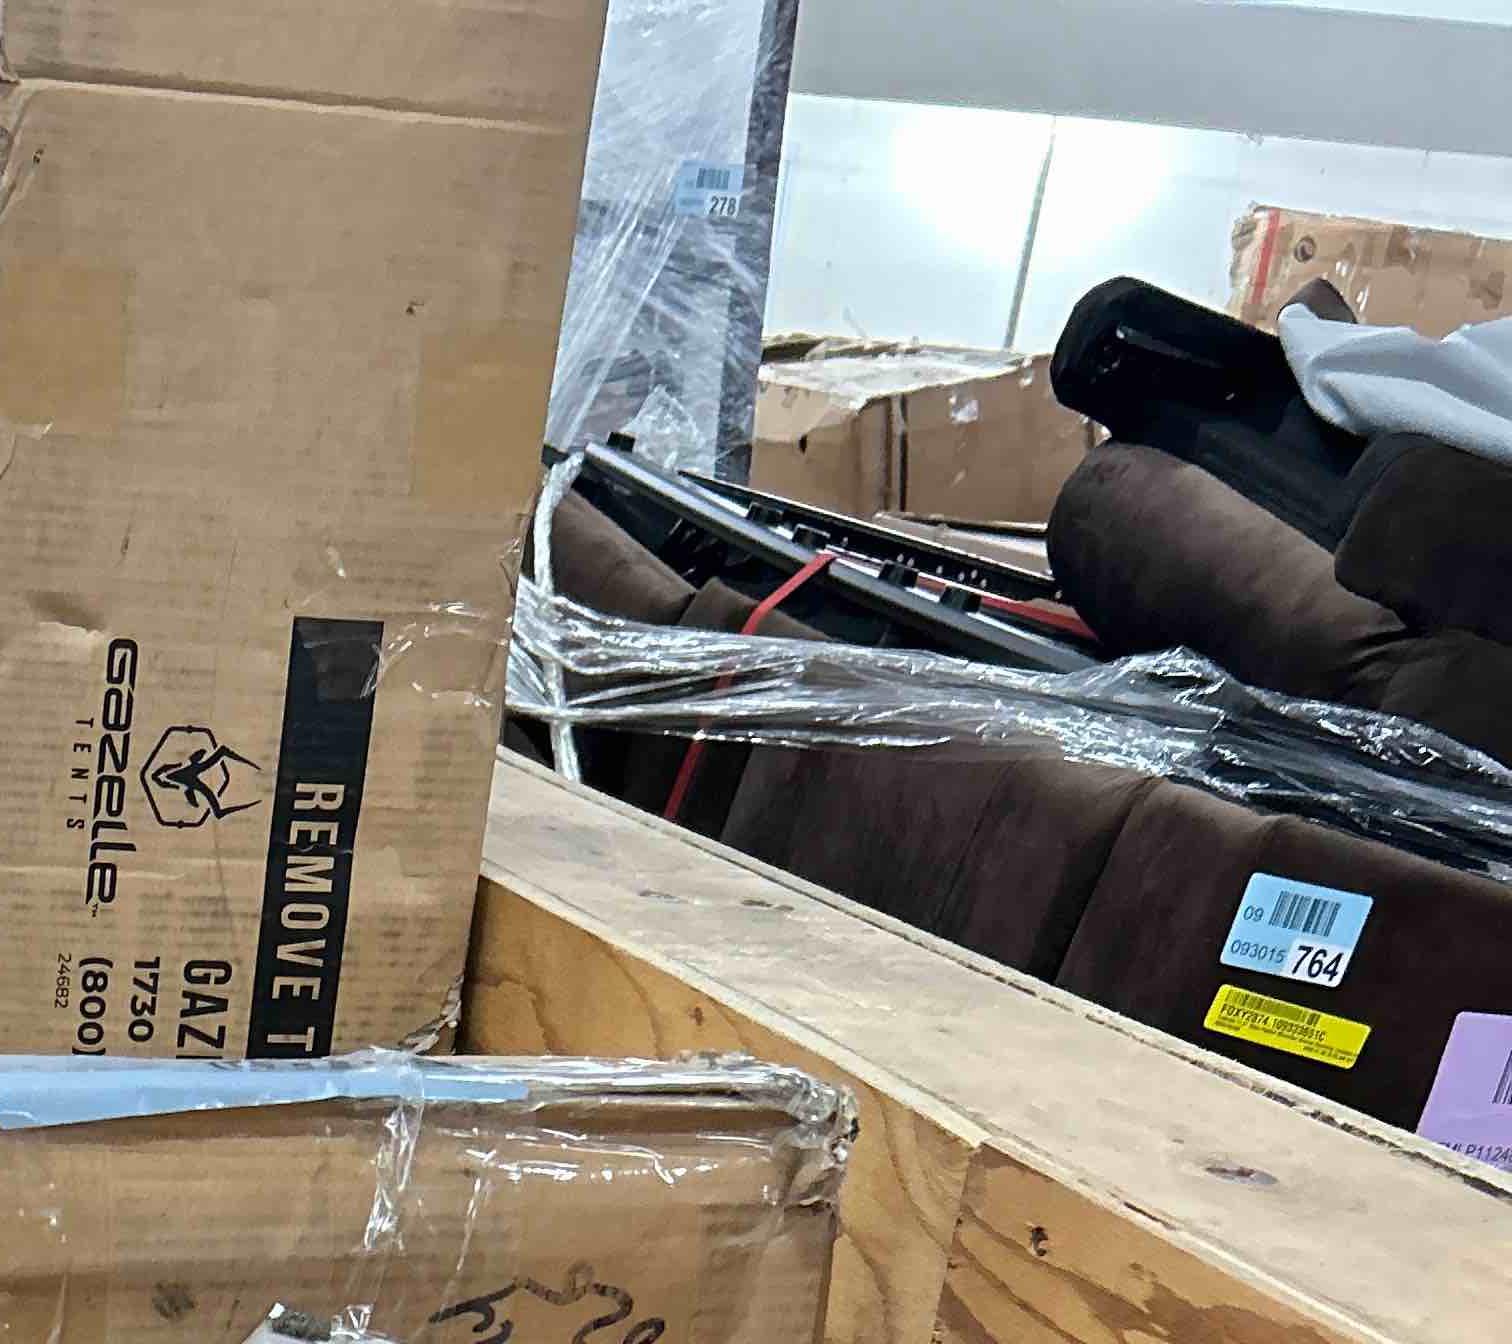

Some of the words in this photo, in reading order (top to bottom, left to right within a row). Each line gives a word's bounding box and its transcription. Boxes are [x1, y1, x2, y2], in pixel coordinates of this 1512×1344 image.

[709, 195, 737, 216] 278
[64, 717, 95, 831] TENTS
[271, 783, 345, 1000] REMOVE
[1243, 904, 1264, 922] 09
[128, 957, 160, 1042] 1730
[1230, 938, 1287, 964] 093015
[1289, 945, 1344, 983] 764
[176, 960, 232, 1059] GAZ
